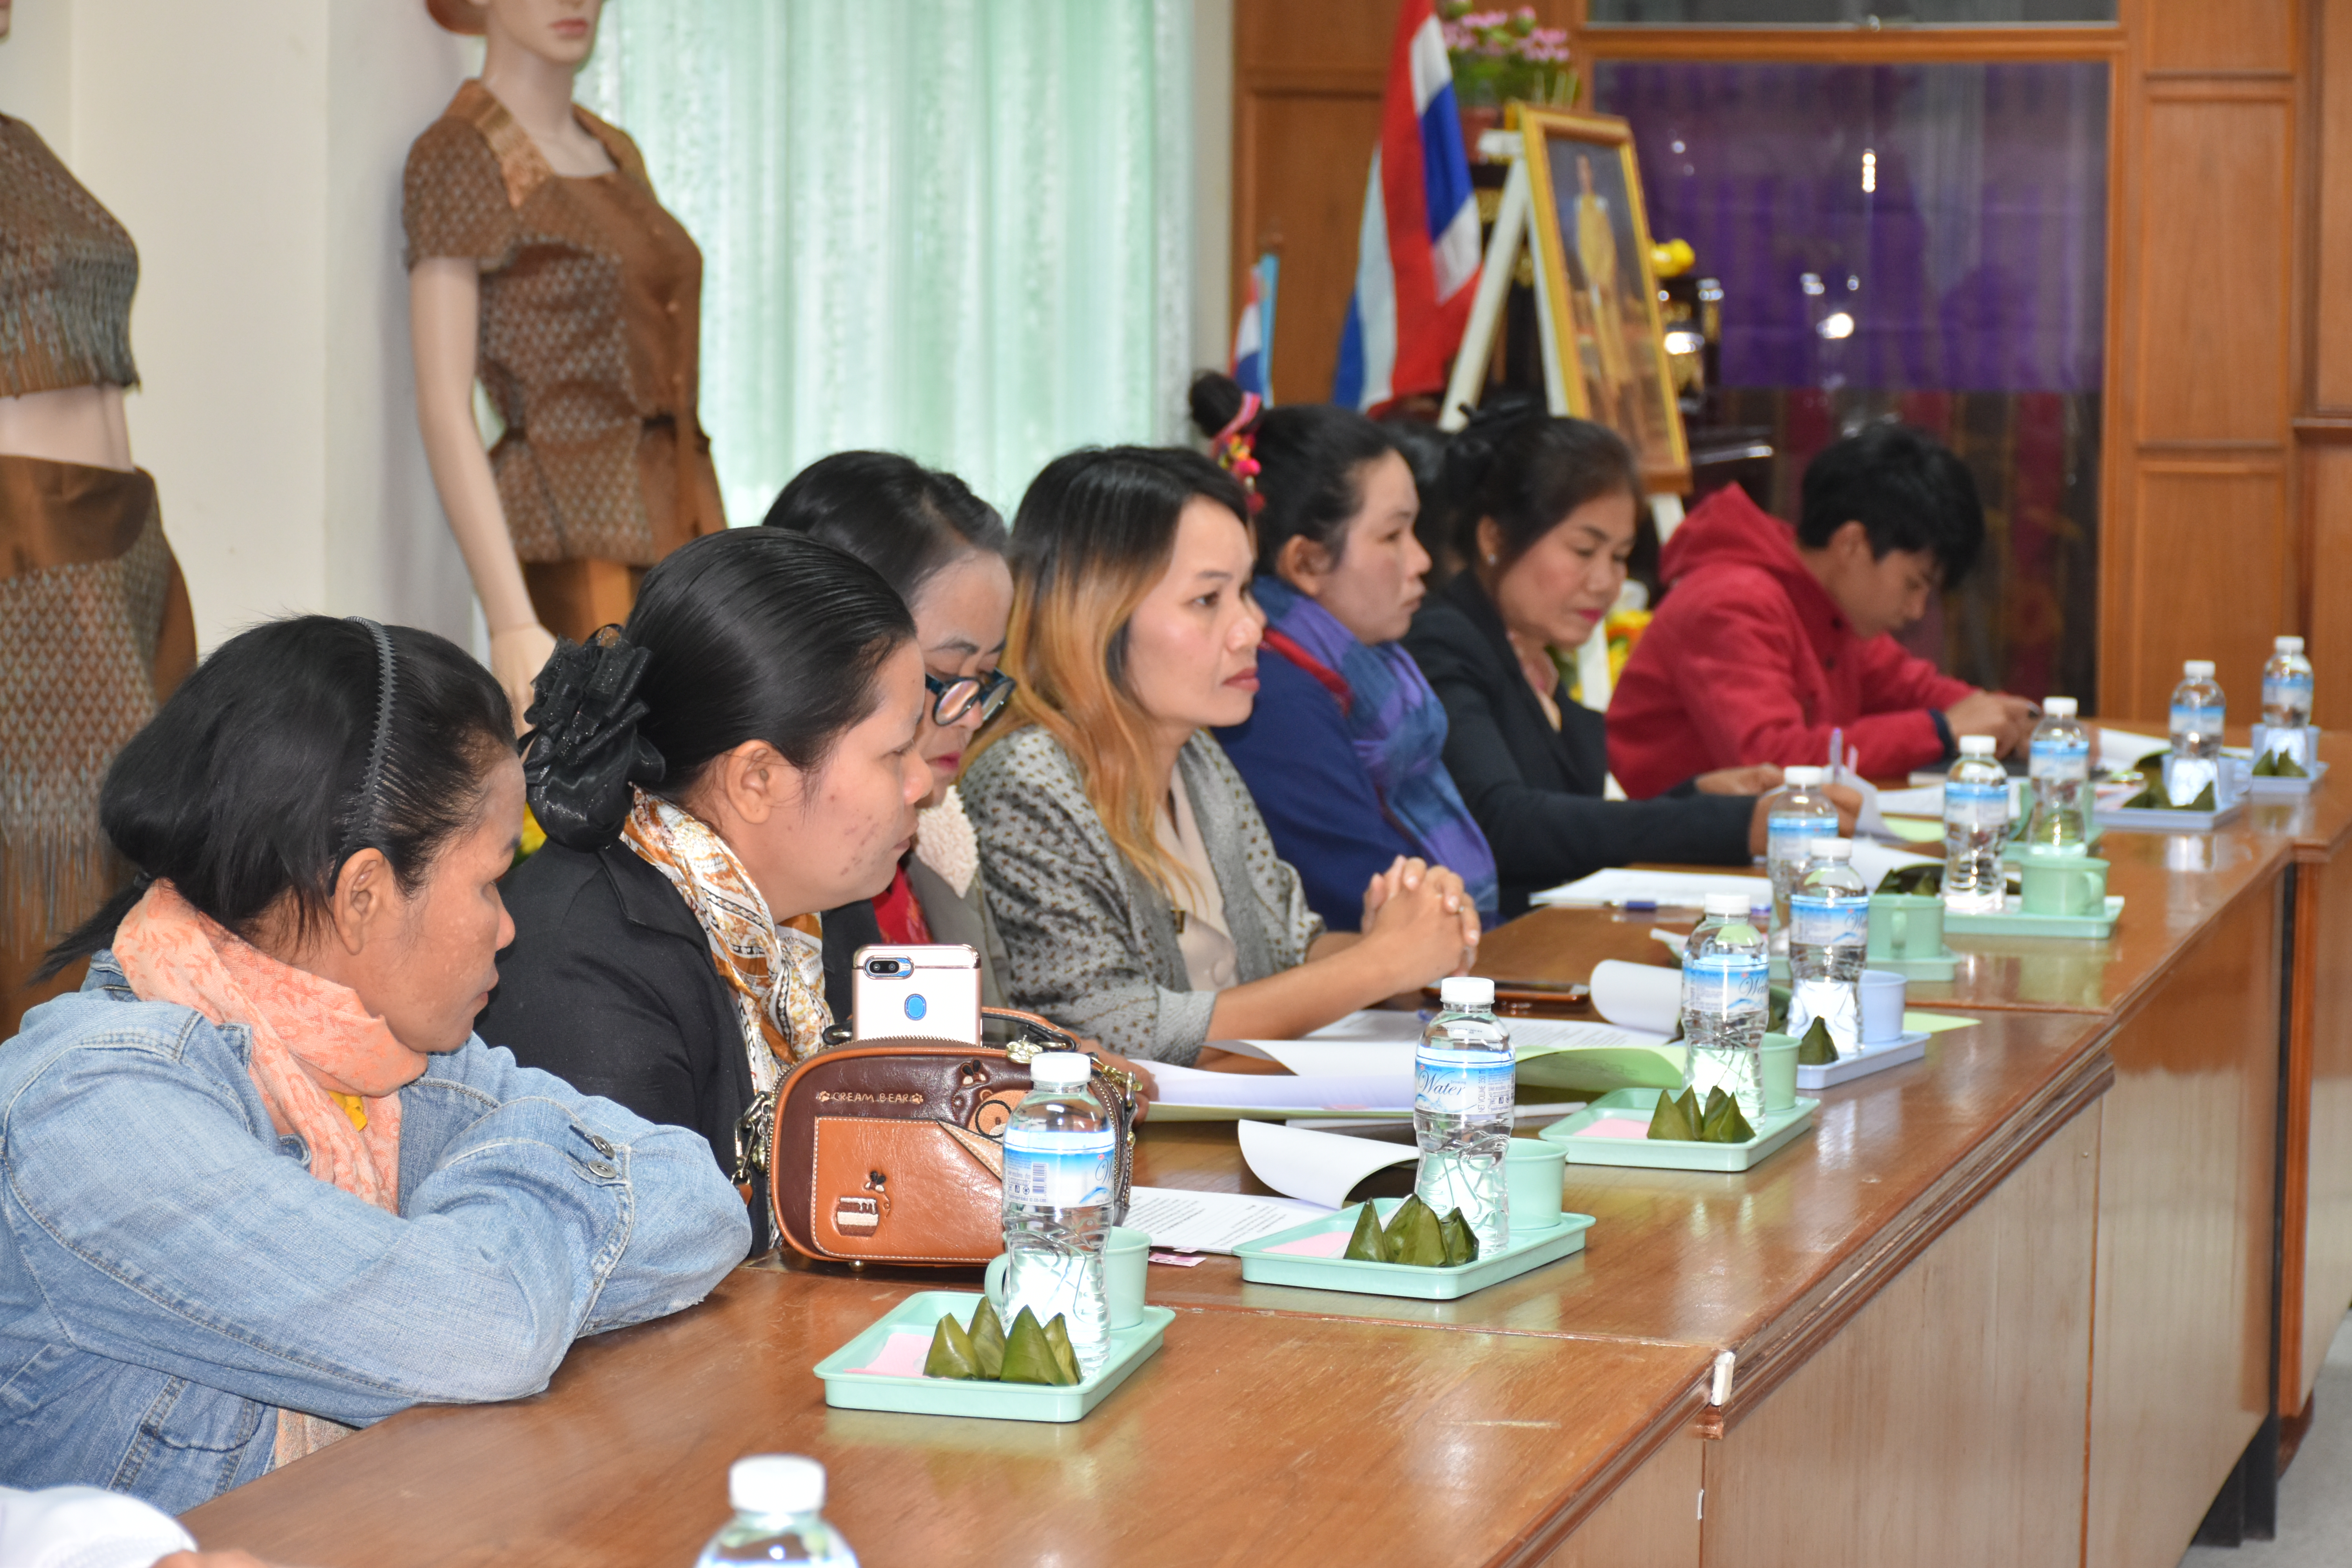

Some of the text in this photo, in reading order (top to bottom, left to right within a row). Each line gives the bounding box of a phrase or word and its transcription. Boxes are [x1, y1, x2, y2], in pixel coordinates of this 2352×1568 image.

[1418, 1070, 1466, 1095] Water
[833, 1092, 909, 1103] CREAM BEAR
